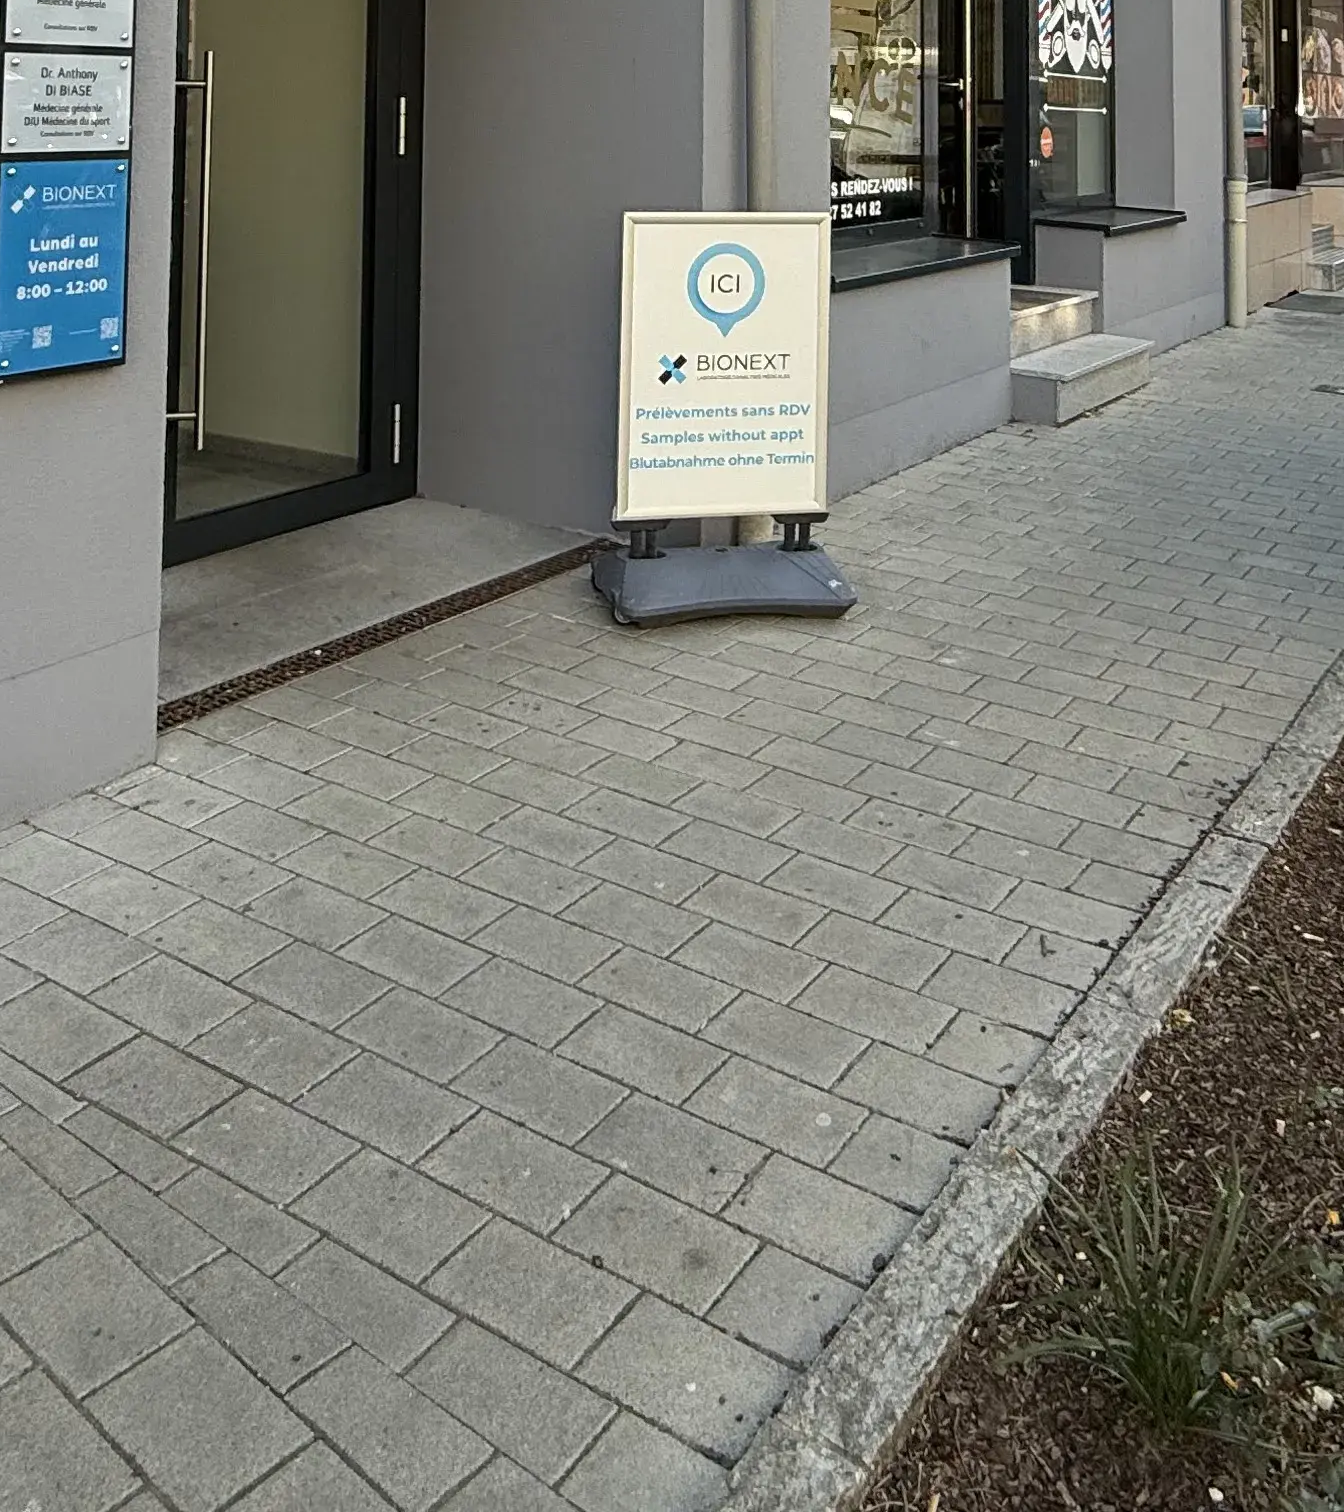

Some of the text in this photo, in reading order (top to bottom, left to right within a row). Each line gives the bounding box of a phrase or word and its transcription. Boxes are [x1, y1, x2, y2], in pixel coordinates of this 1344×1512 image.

[57, 67, 98, 82] Anthony
[45, 85, 92, 96] DI BIASE
[42, 183, 117, 202] BIONEXT
[830, 200, 881, 220] 7 52 41 82
[30, 234, 99, 252] Lundi au
[28, 253, 99, 274] Vendredi
[16, 283, 51, 300] 8:00
[66, 278, 108, 296] 12:00
[710, 274, 740, 293] ICI
[697, 353, 791, 371] BIONEXT
[636, 404, 811, 420] Prélèvements sans RDV
[641, 428, 804, 446] Samples without appt
[630, 452, 815, 470] Blutabnahme ohne Termin
